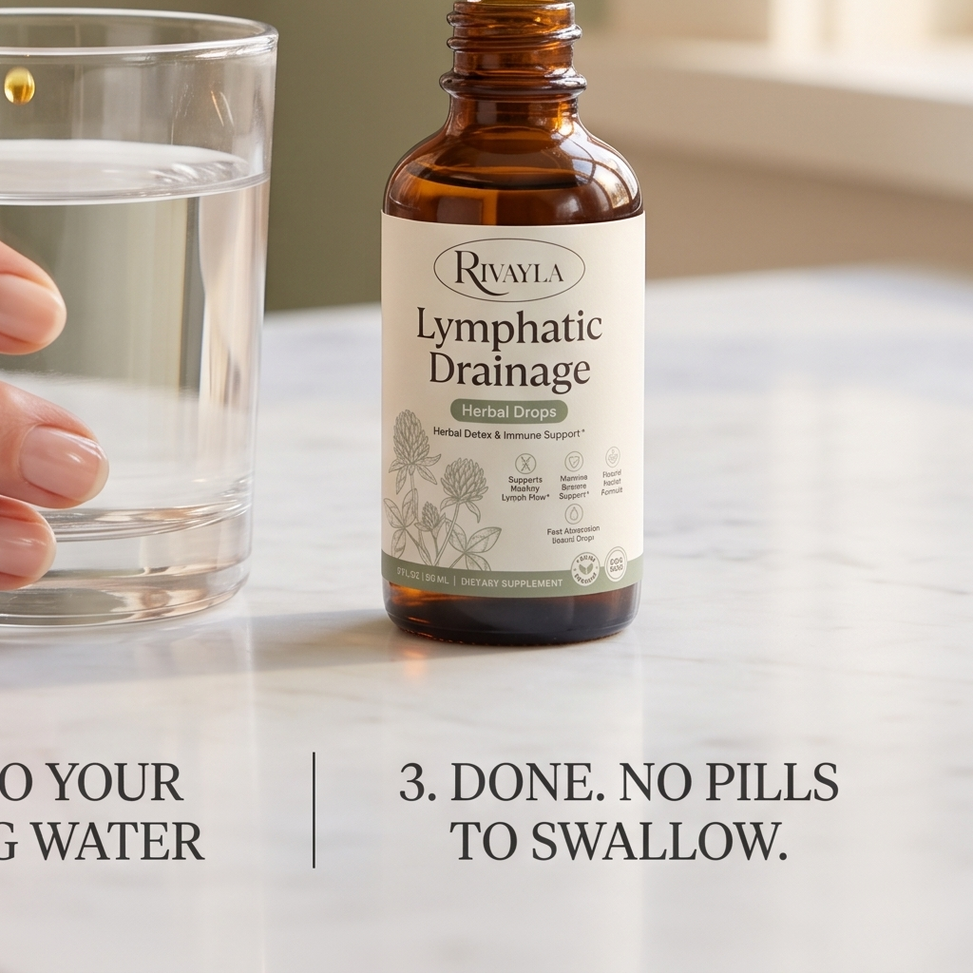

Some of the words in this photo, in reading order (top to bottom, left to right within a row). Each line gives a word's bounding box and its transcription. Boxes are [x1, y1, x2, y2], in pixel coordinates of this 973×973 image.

[416, 306, 603, 352] Lymphatic
[429, 351, 591, 395] Drainage
[462, 404, 509, 418] Herbal
[514, 405, 557, 421] Drops
[433, 427, 462, 438] Herbal
[494, 430, 501, 440] &
[504, 430, 542, 440] Immune
[501, 578, 563, 588] SUPPLEMENT
